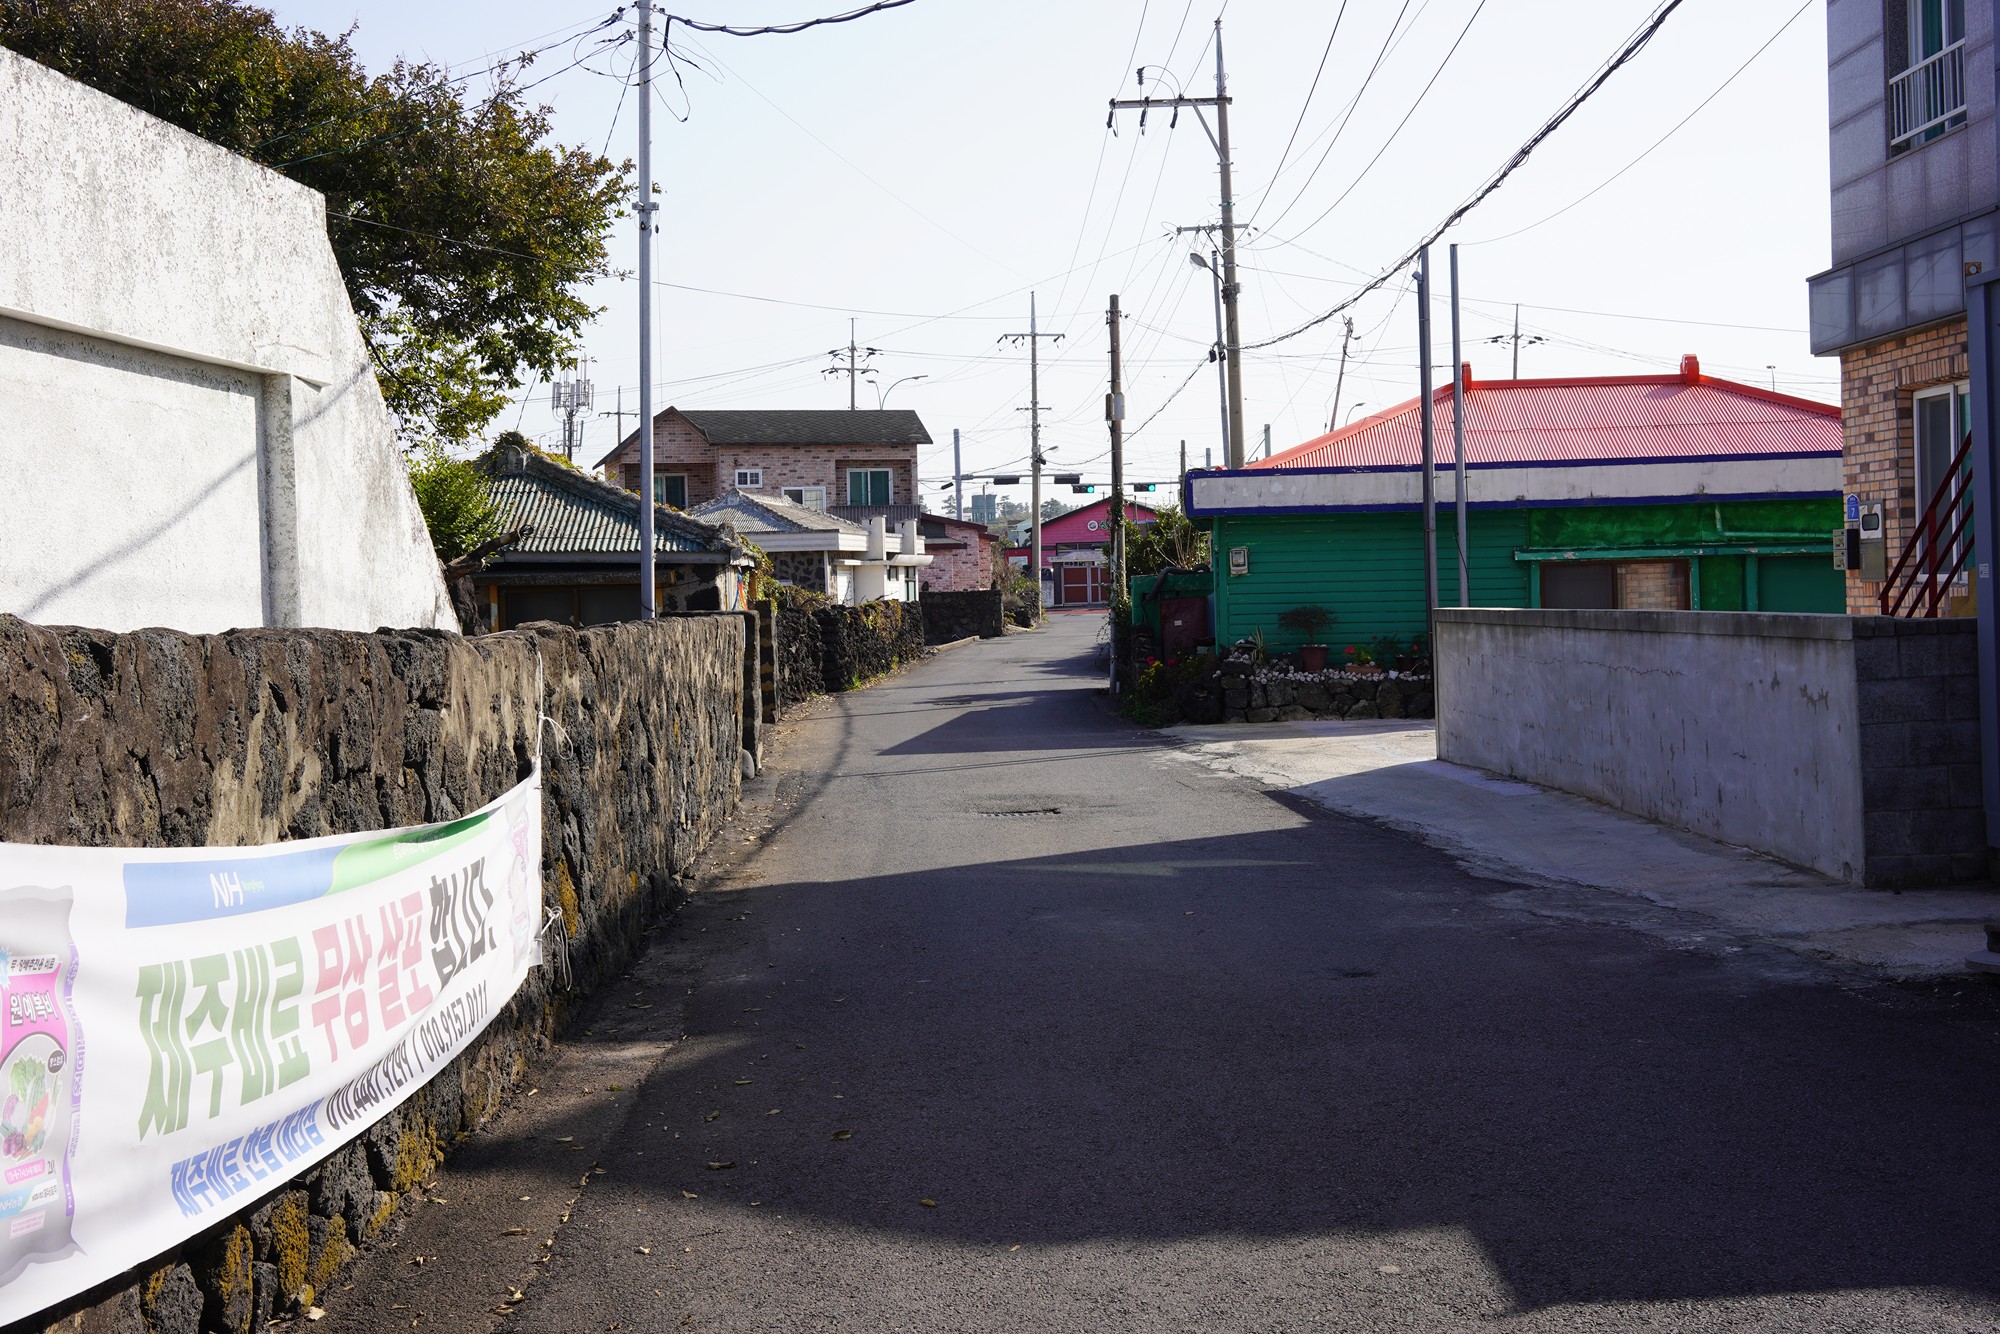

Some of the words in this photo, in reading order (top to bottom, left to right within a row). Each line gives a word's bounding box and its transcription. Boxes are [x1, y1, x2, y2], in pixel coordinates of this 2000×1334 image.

[1850, 507, 1856, 518] 7
[209, 871, 244, 909] NH
[10, 990, 58, 1027] 원예복비
[134, 935, 311, 1142] 제주비료
[311, 912, 373, 1064] 무상
[377, 890, 433, 1032] 살포
[429, 855, 497, 991] 합니다.
[419, 979, 488, 1063] 010.9157.0111
[171, 1136, 252, 1219] 제주비료
[242, 1119, 284, 1182] 한림
[276, 1097, 326, 1163] 대리점
